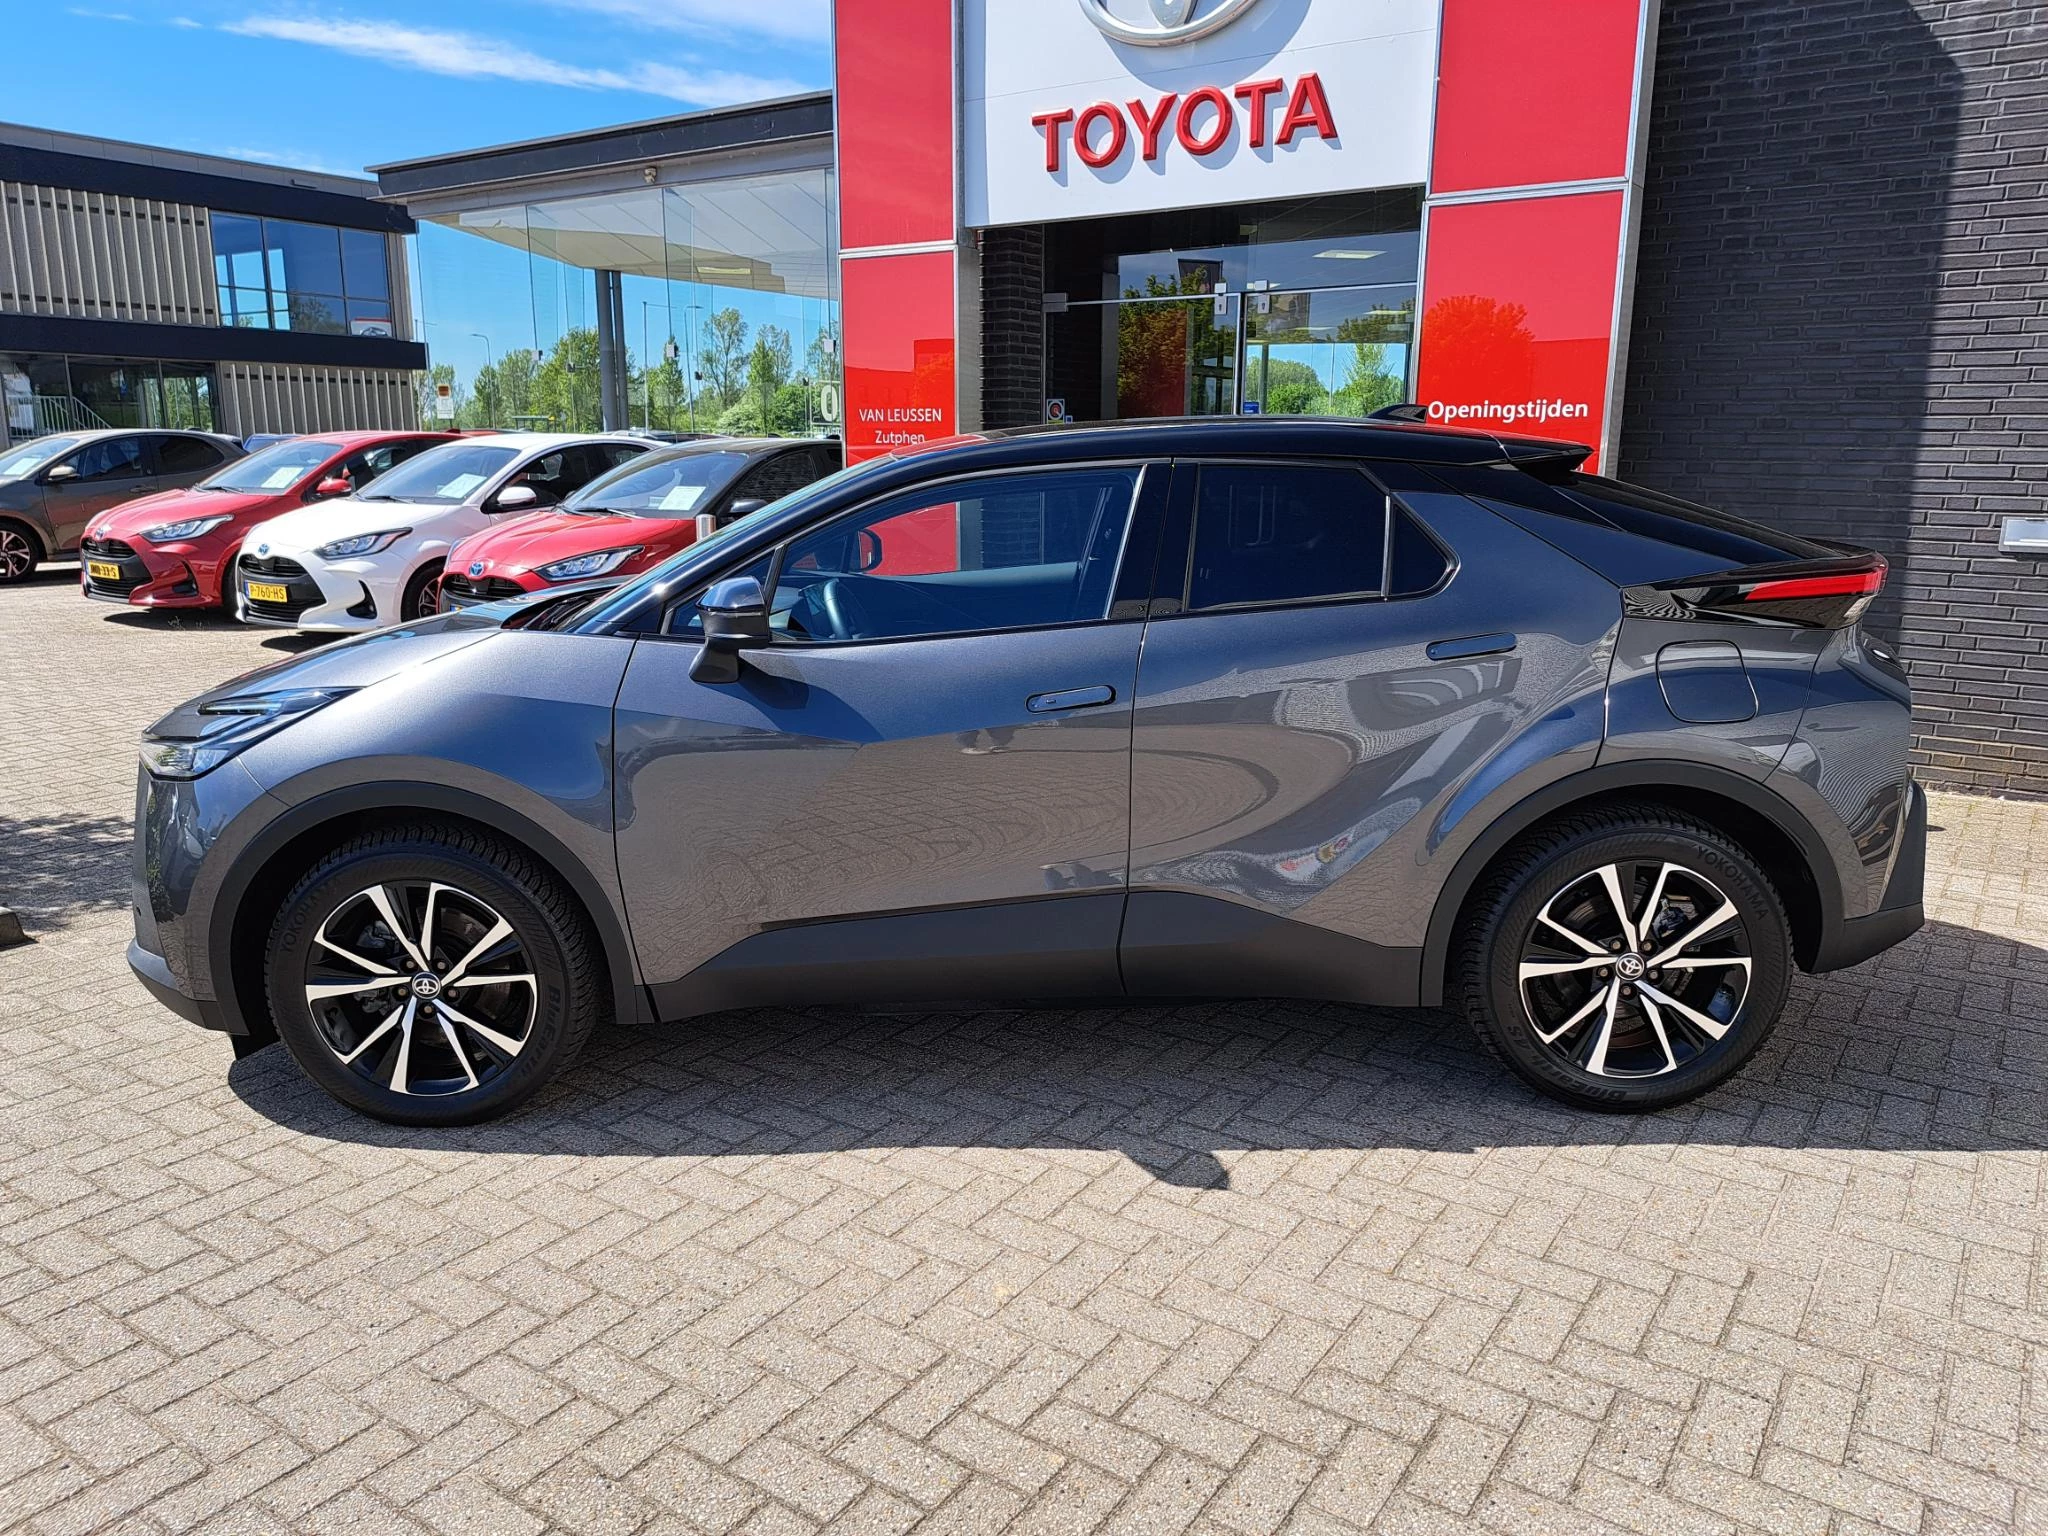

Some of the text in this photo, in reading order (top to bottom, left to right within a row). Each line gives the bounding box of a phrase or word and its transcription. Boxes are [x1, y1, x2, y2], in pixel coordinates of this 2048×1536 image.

[1031, 72, 1339, 173] TOYOTA
[859, 408, 942, 423] VAN LEUSSEN
[1428, 399, 1589, 424] Openingstijden
[875, 430, 925, 446] Zutphen
[1696, 846, 1769, 920] YOKOHAMA
